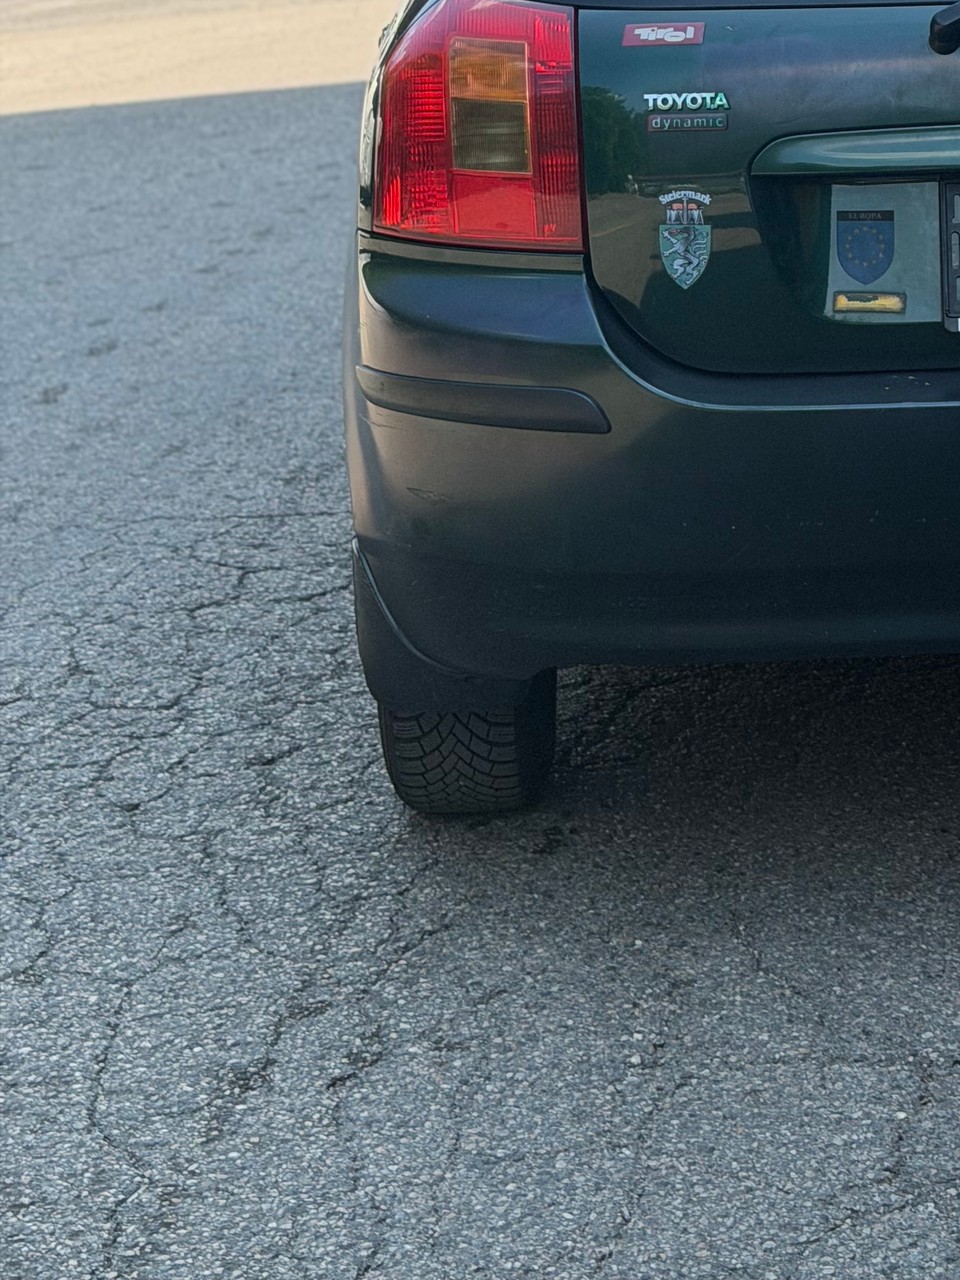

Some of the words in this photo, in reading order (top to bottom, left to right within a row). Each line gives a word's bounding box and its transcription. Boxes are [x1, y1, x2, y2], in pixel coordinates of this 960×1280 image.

[634, 26, 695, 42] Tirol
[643, 92, 730, 111] TOYOTA
[652, 116, 724, 130] dynamic
[659, 190, 712, 205] Steiermark
